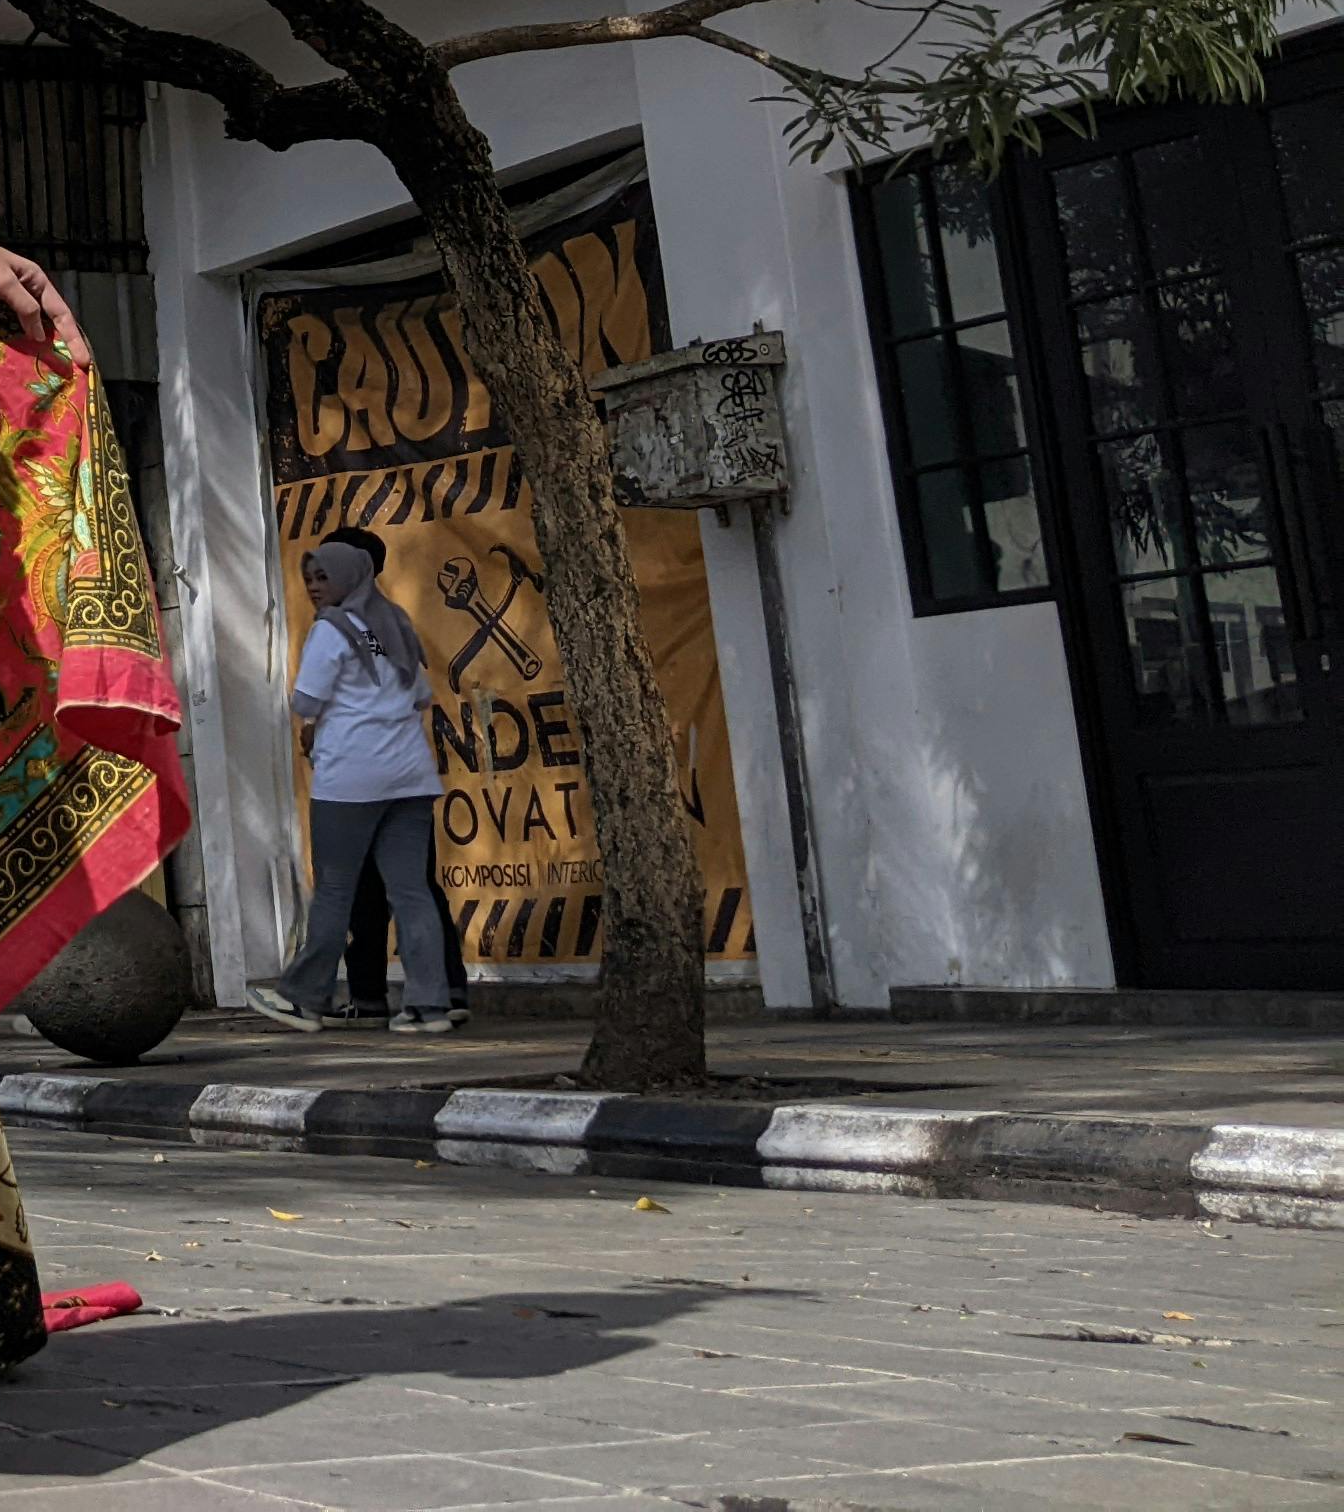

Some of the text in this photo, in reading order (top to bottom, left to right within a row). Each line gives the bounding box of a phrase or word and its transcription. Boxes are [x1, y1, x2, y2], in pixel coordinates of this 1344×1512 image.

[288, 219, 651, 456] CAUTN
[431, 690, 580, 775] NDE
[441, 862, 532, 888] KOMPOSISI
